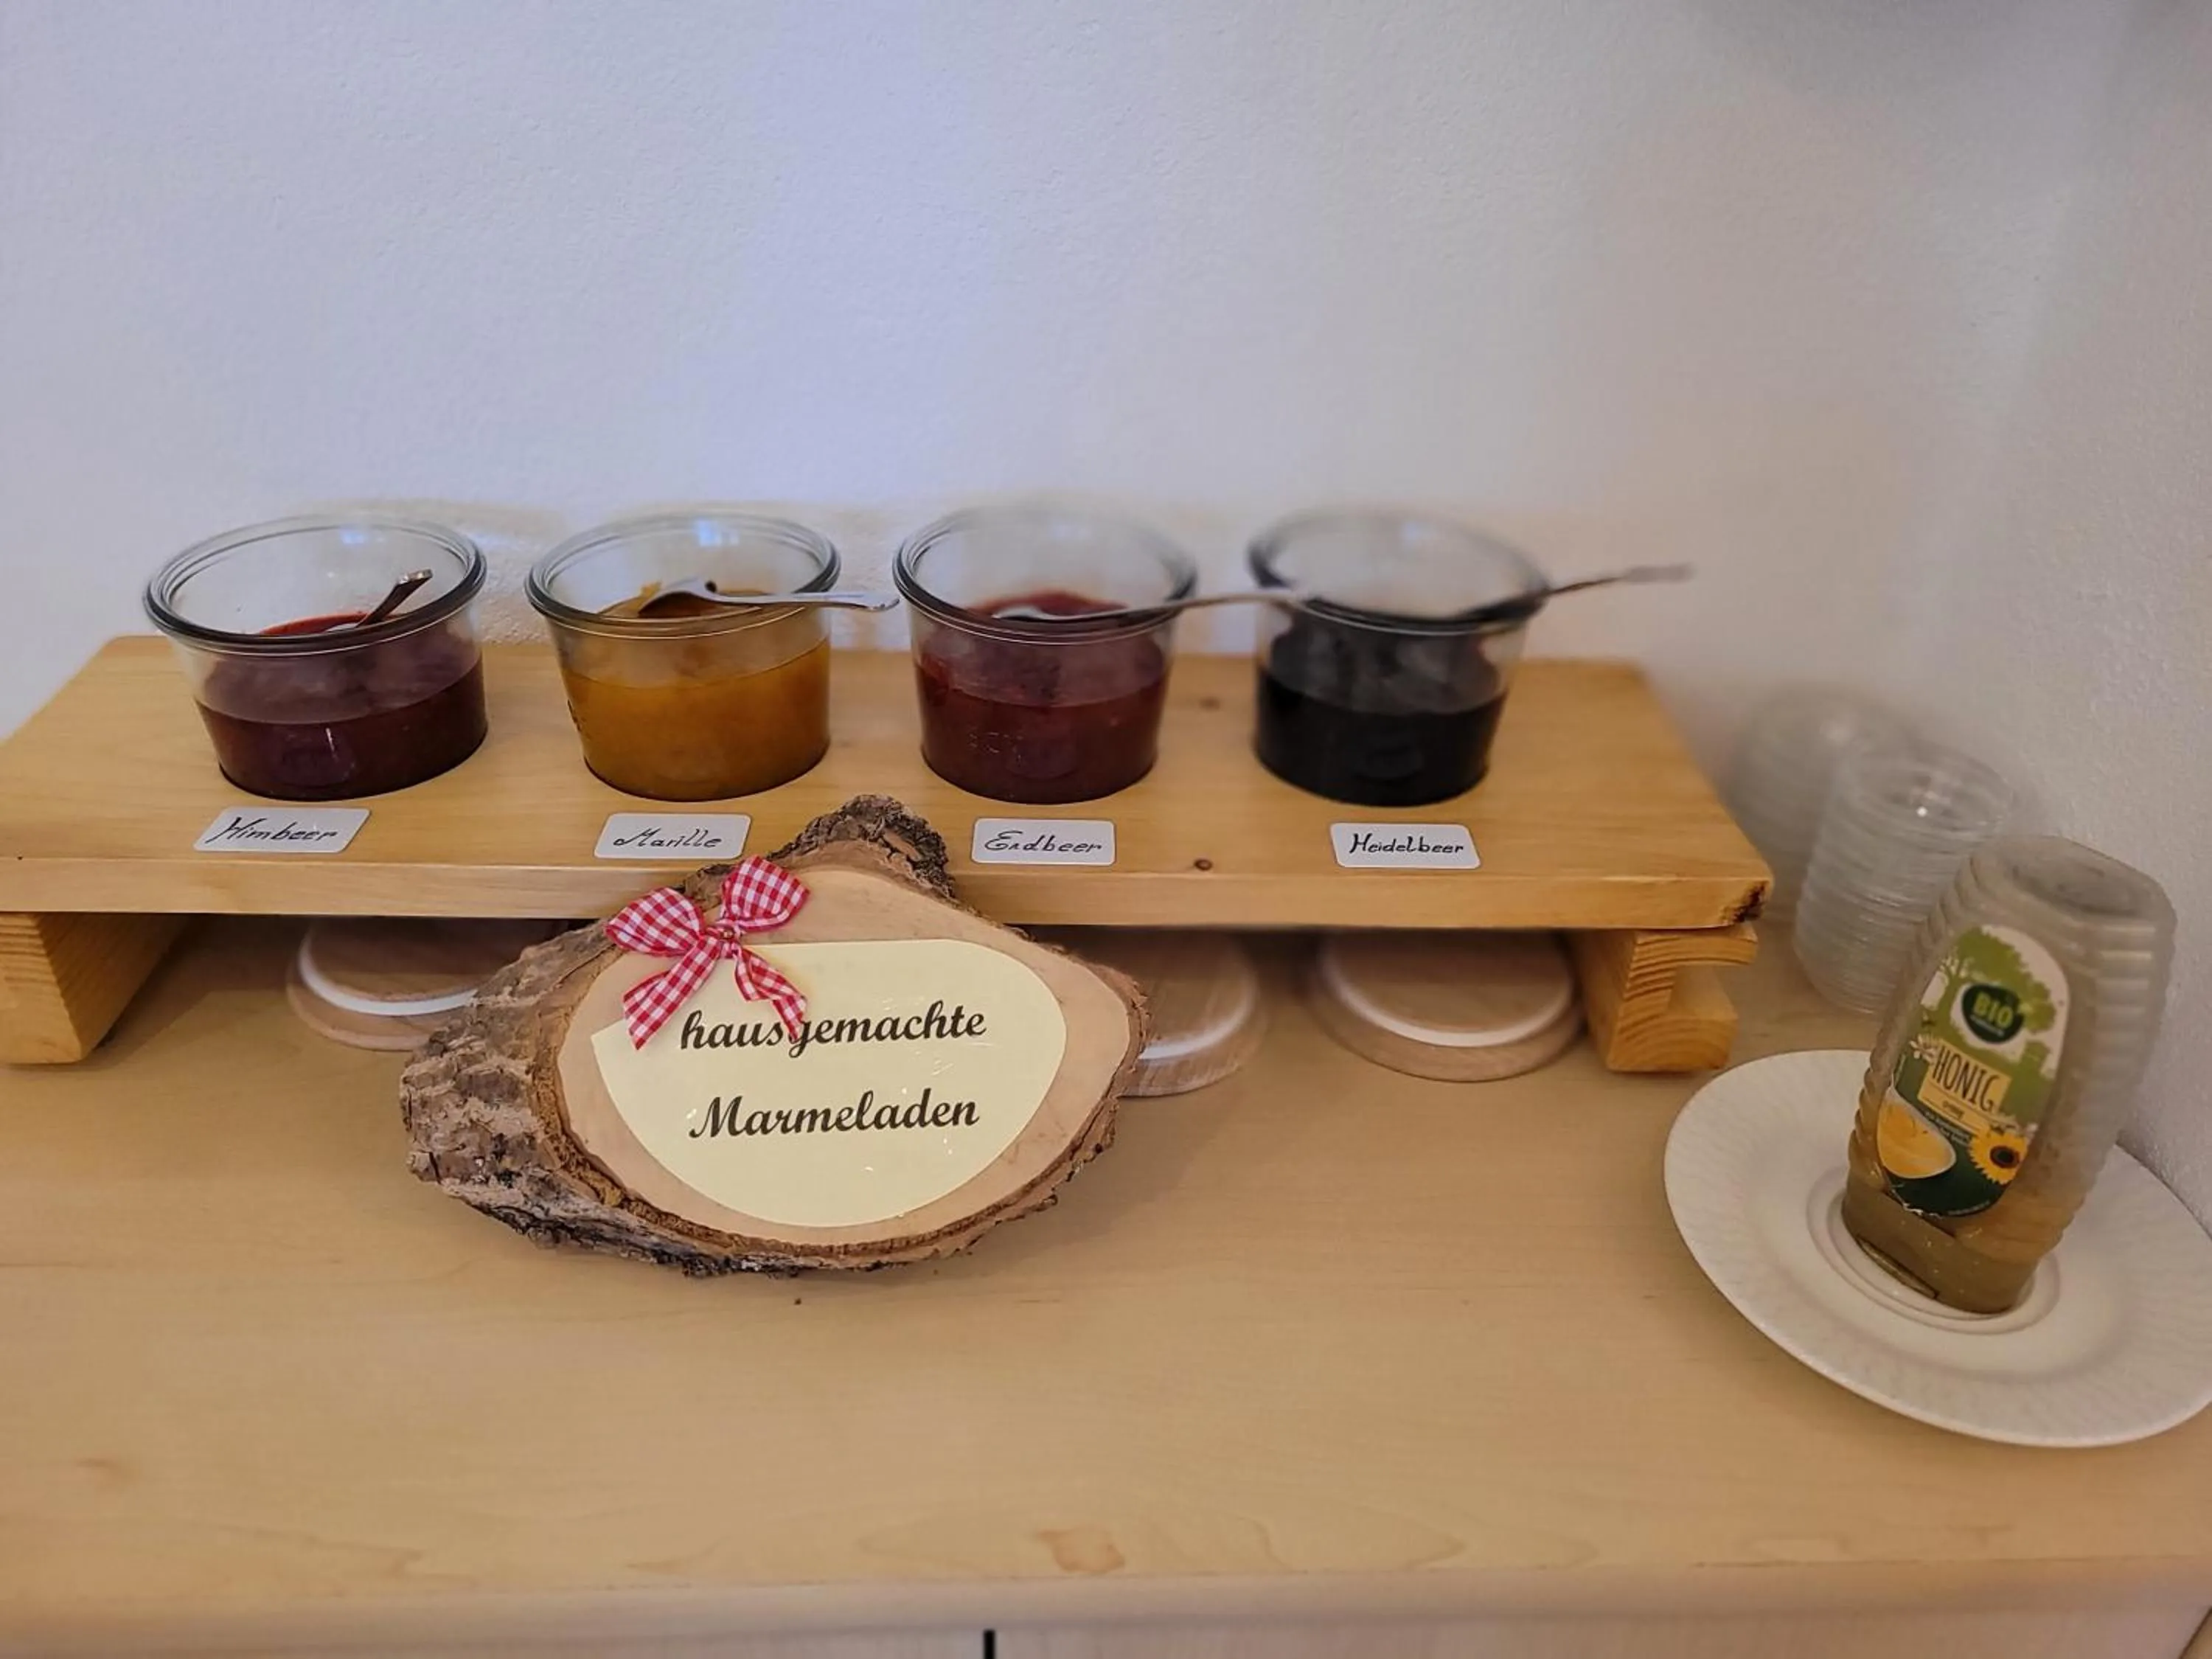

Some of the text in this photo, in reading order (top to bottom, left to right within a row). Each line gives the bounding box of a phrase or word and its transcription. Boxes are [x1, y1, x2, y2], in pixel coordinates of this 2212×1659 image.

[204, 816, 338, 844] Himbeer
[613, 827, 723, 848] Marille
[984, 830, 1102, 853] Erdbeer
[1349, 832, 1464, 854] Heidelbeer
[1974, 992, 2014, 1029] BIO
[680, 1000, 987, 1059] hausgemachte
[1932, 1046, 2000, 1112] HONIG
[688, 1087, 980, 1138] Marmeladen
